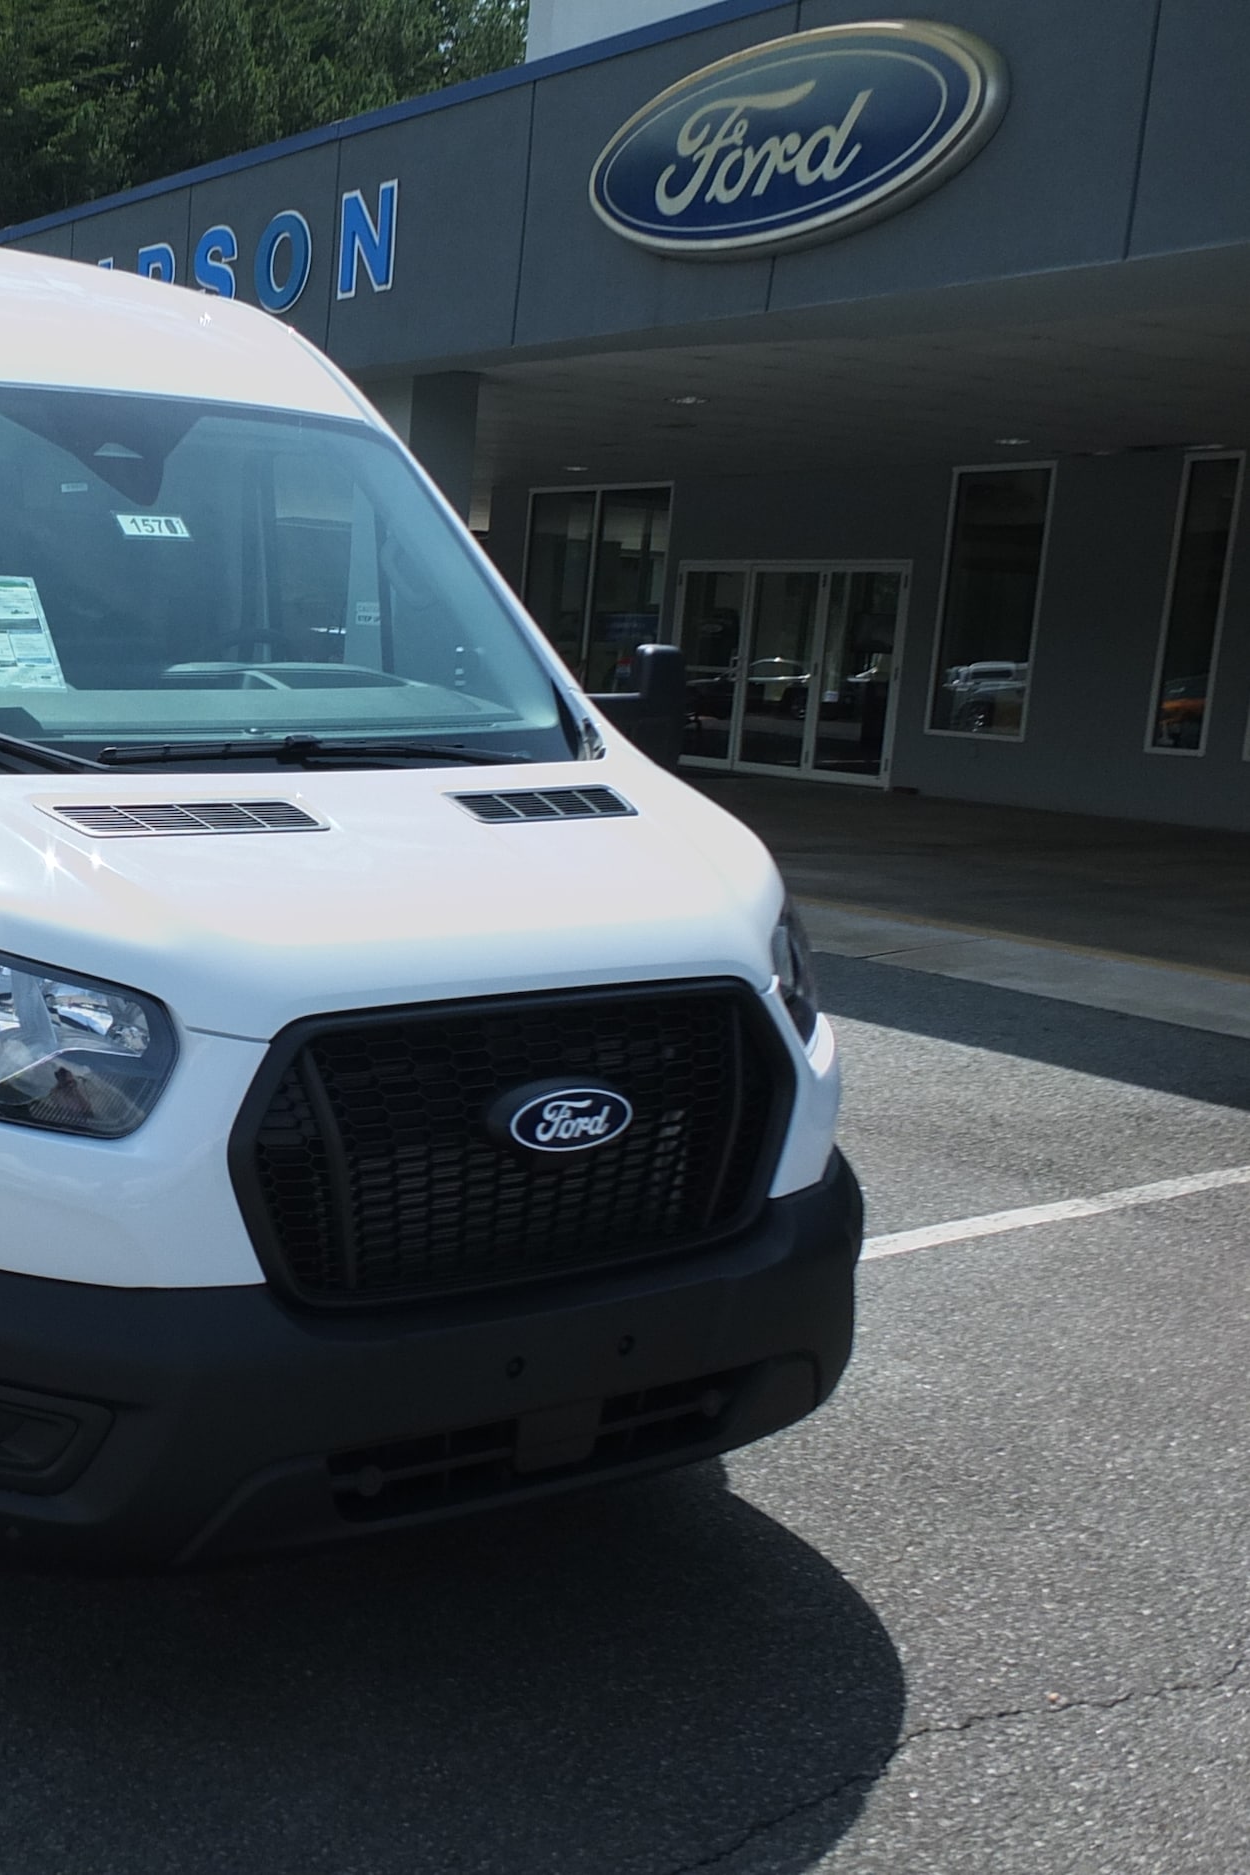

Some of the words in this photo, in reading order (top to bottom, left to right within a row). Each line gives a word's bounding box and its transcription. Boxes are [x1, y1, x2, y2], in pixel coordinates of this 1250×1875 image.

[654, 79, 874, 217] Ford
[98, 178, 399, 314] SON
[535, 1099, 611, 1142] Ford
